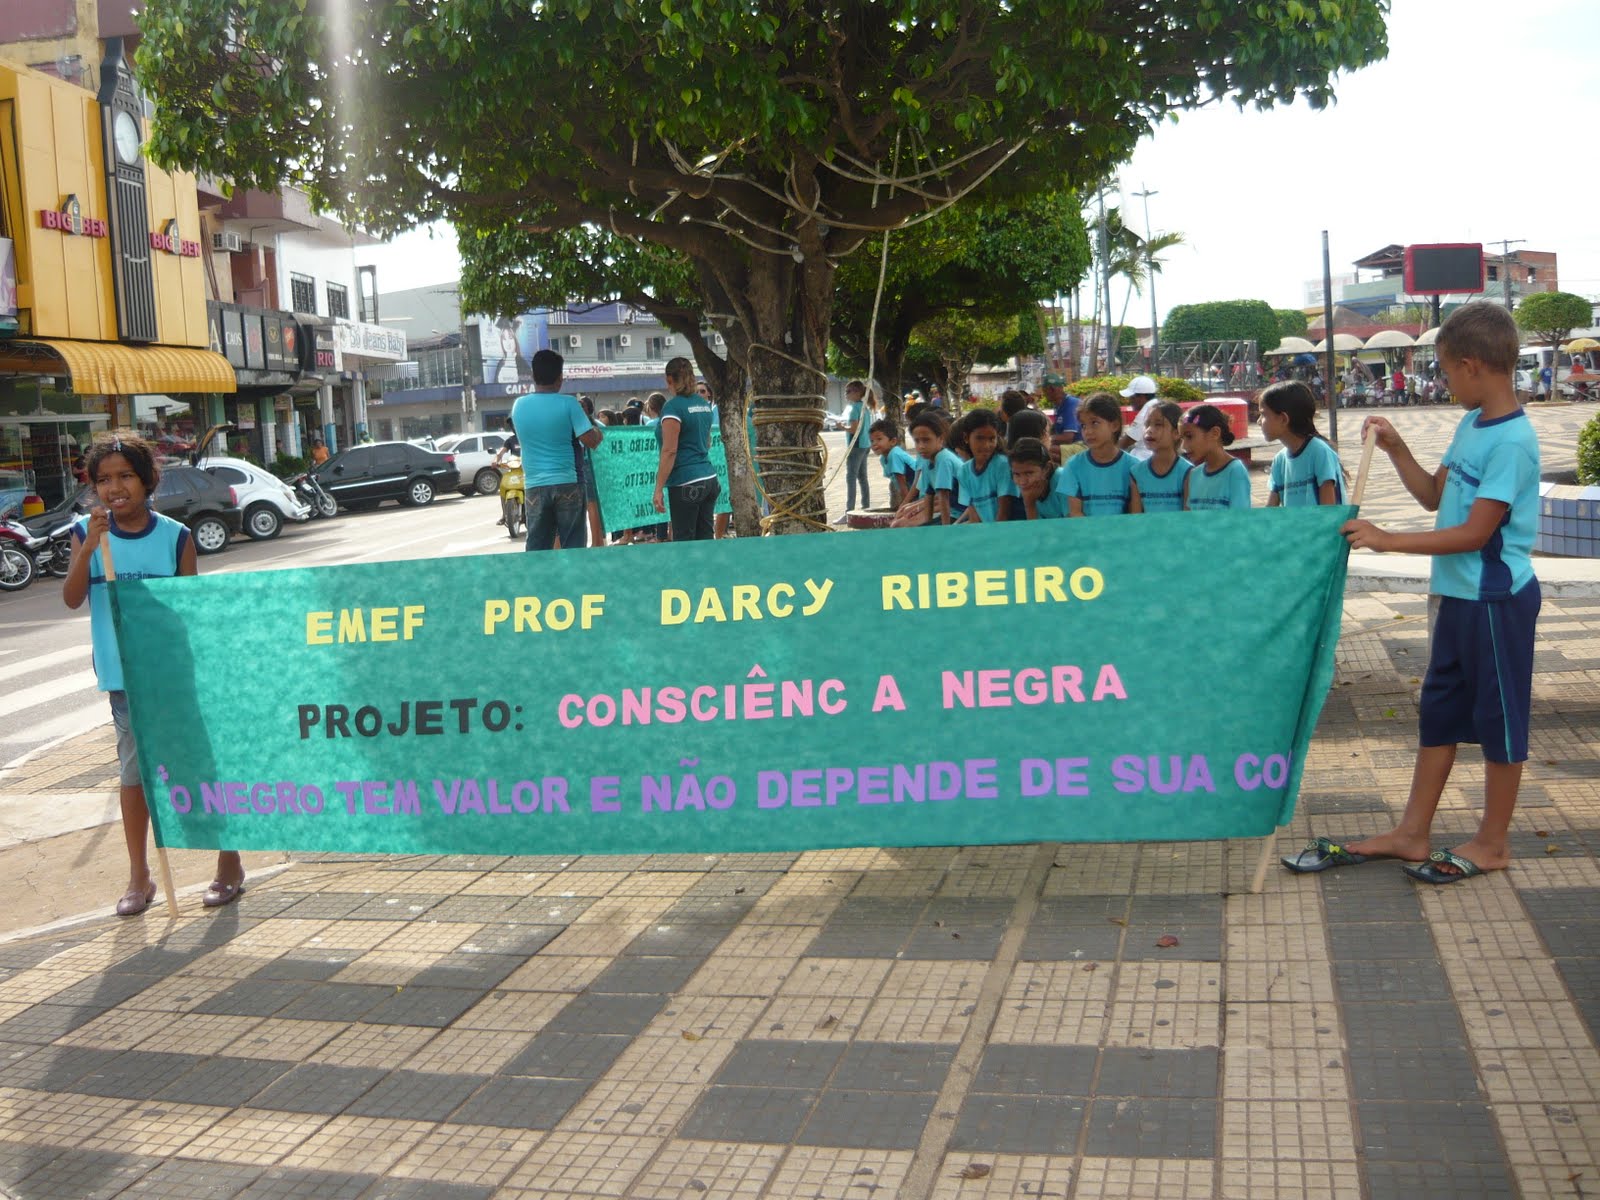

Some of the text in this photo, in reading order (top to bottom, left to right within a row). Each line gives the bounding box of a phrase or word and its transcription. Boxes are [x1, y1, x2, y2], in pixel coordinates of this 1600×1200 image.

[41, 209, 107, 238] BIG BEN
[150, 232, 200, 258] BIG BEN
[225, 331, 243, 347] CAOS
[363, 328, 387, 352] Jeans
[387, 331, 405, 357] Baby
[316, 351, 335, 368] RIO
[505, 383, 536, 395] CAIXA
[305, 605, 425, 646] EMEF
[483, 594, 606, 635] PROF
[881, 566, 1105, 611] RIBEIRO
[297, 698, 525, 740] PROJETO:
[871, 674, 906, 713] A
[941, 663, 1128, 709] NEGRA
[200, 780, 325, 815] NEGRO
[334, 780, 422, 815] TEM
[433, 777, 570, 815] VALOR
[591, 776, 622, 813] E
[642, 757, 736, 812] NÃO
[757, 758, 998, 809] DEPENDE
[1020, 757, 1090, 798] DE
[1111, 753, 1216, 794] SUA
